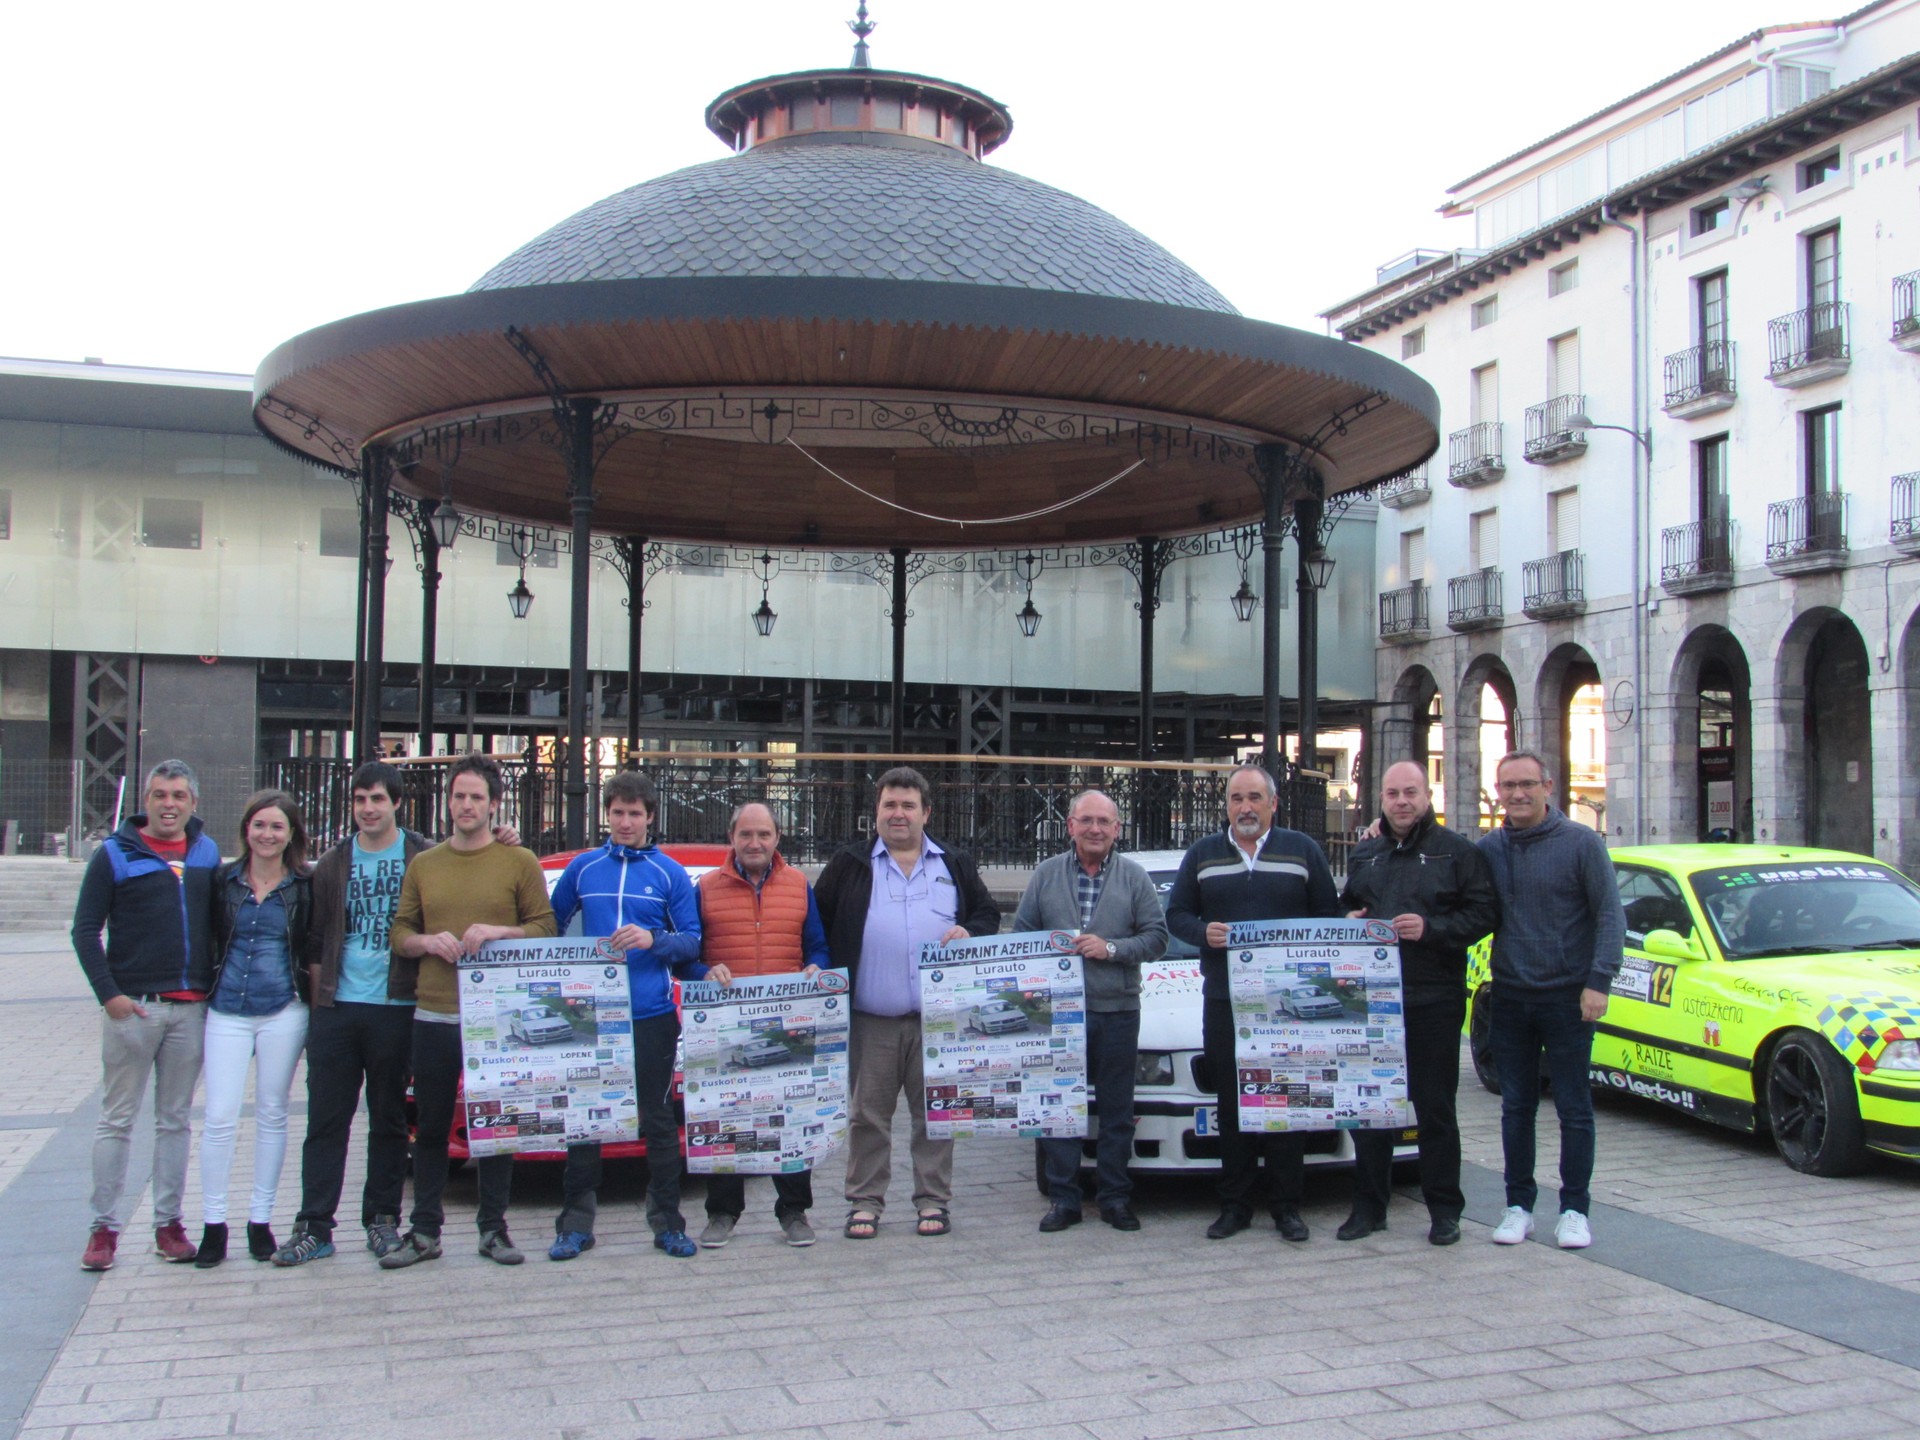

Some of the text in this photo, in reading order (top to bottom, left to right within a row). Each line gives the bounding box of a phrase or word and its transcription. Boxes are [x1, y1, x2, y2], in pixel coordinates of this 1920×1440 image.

[1230, 926, 1368, 945] RALLYSPRINT AZPEITIA
[1376, 927, 1387, 936] 22
[1059, 938, 1070, 947] 22
[460, 946, 599, 964] RALLYSPRINT AZPEITIA
[921, 941, 1053, 963] RALLYSPRINT AZPEITIA
[1286, 947, 1341, 959] Lurauto
[517, 966, 571, 979] Lurauto
[975, 961, 1026, 975] Lurauto
[827, 978, 838, 987] 22
[1651, 965, 1675, 1004] 12
[684, 981, 820, 1004] RALLYSPRINT AZPEITIA
[739, 1002, 792, 1016] Lurauto
[1683, 997, 1744, 1025] asteazkena
[1015, 1040, 1047, 1048] LOPENE
[560, 1051, 593, 1059] LOPENE
[1635, 1043, 1673, 1071] RAIZE
[777, 1070, 809, 1078] LOPENE
